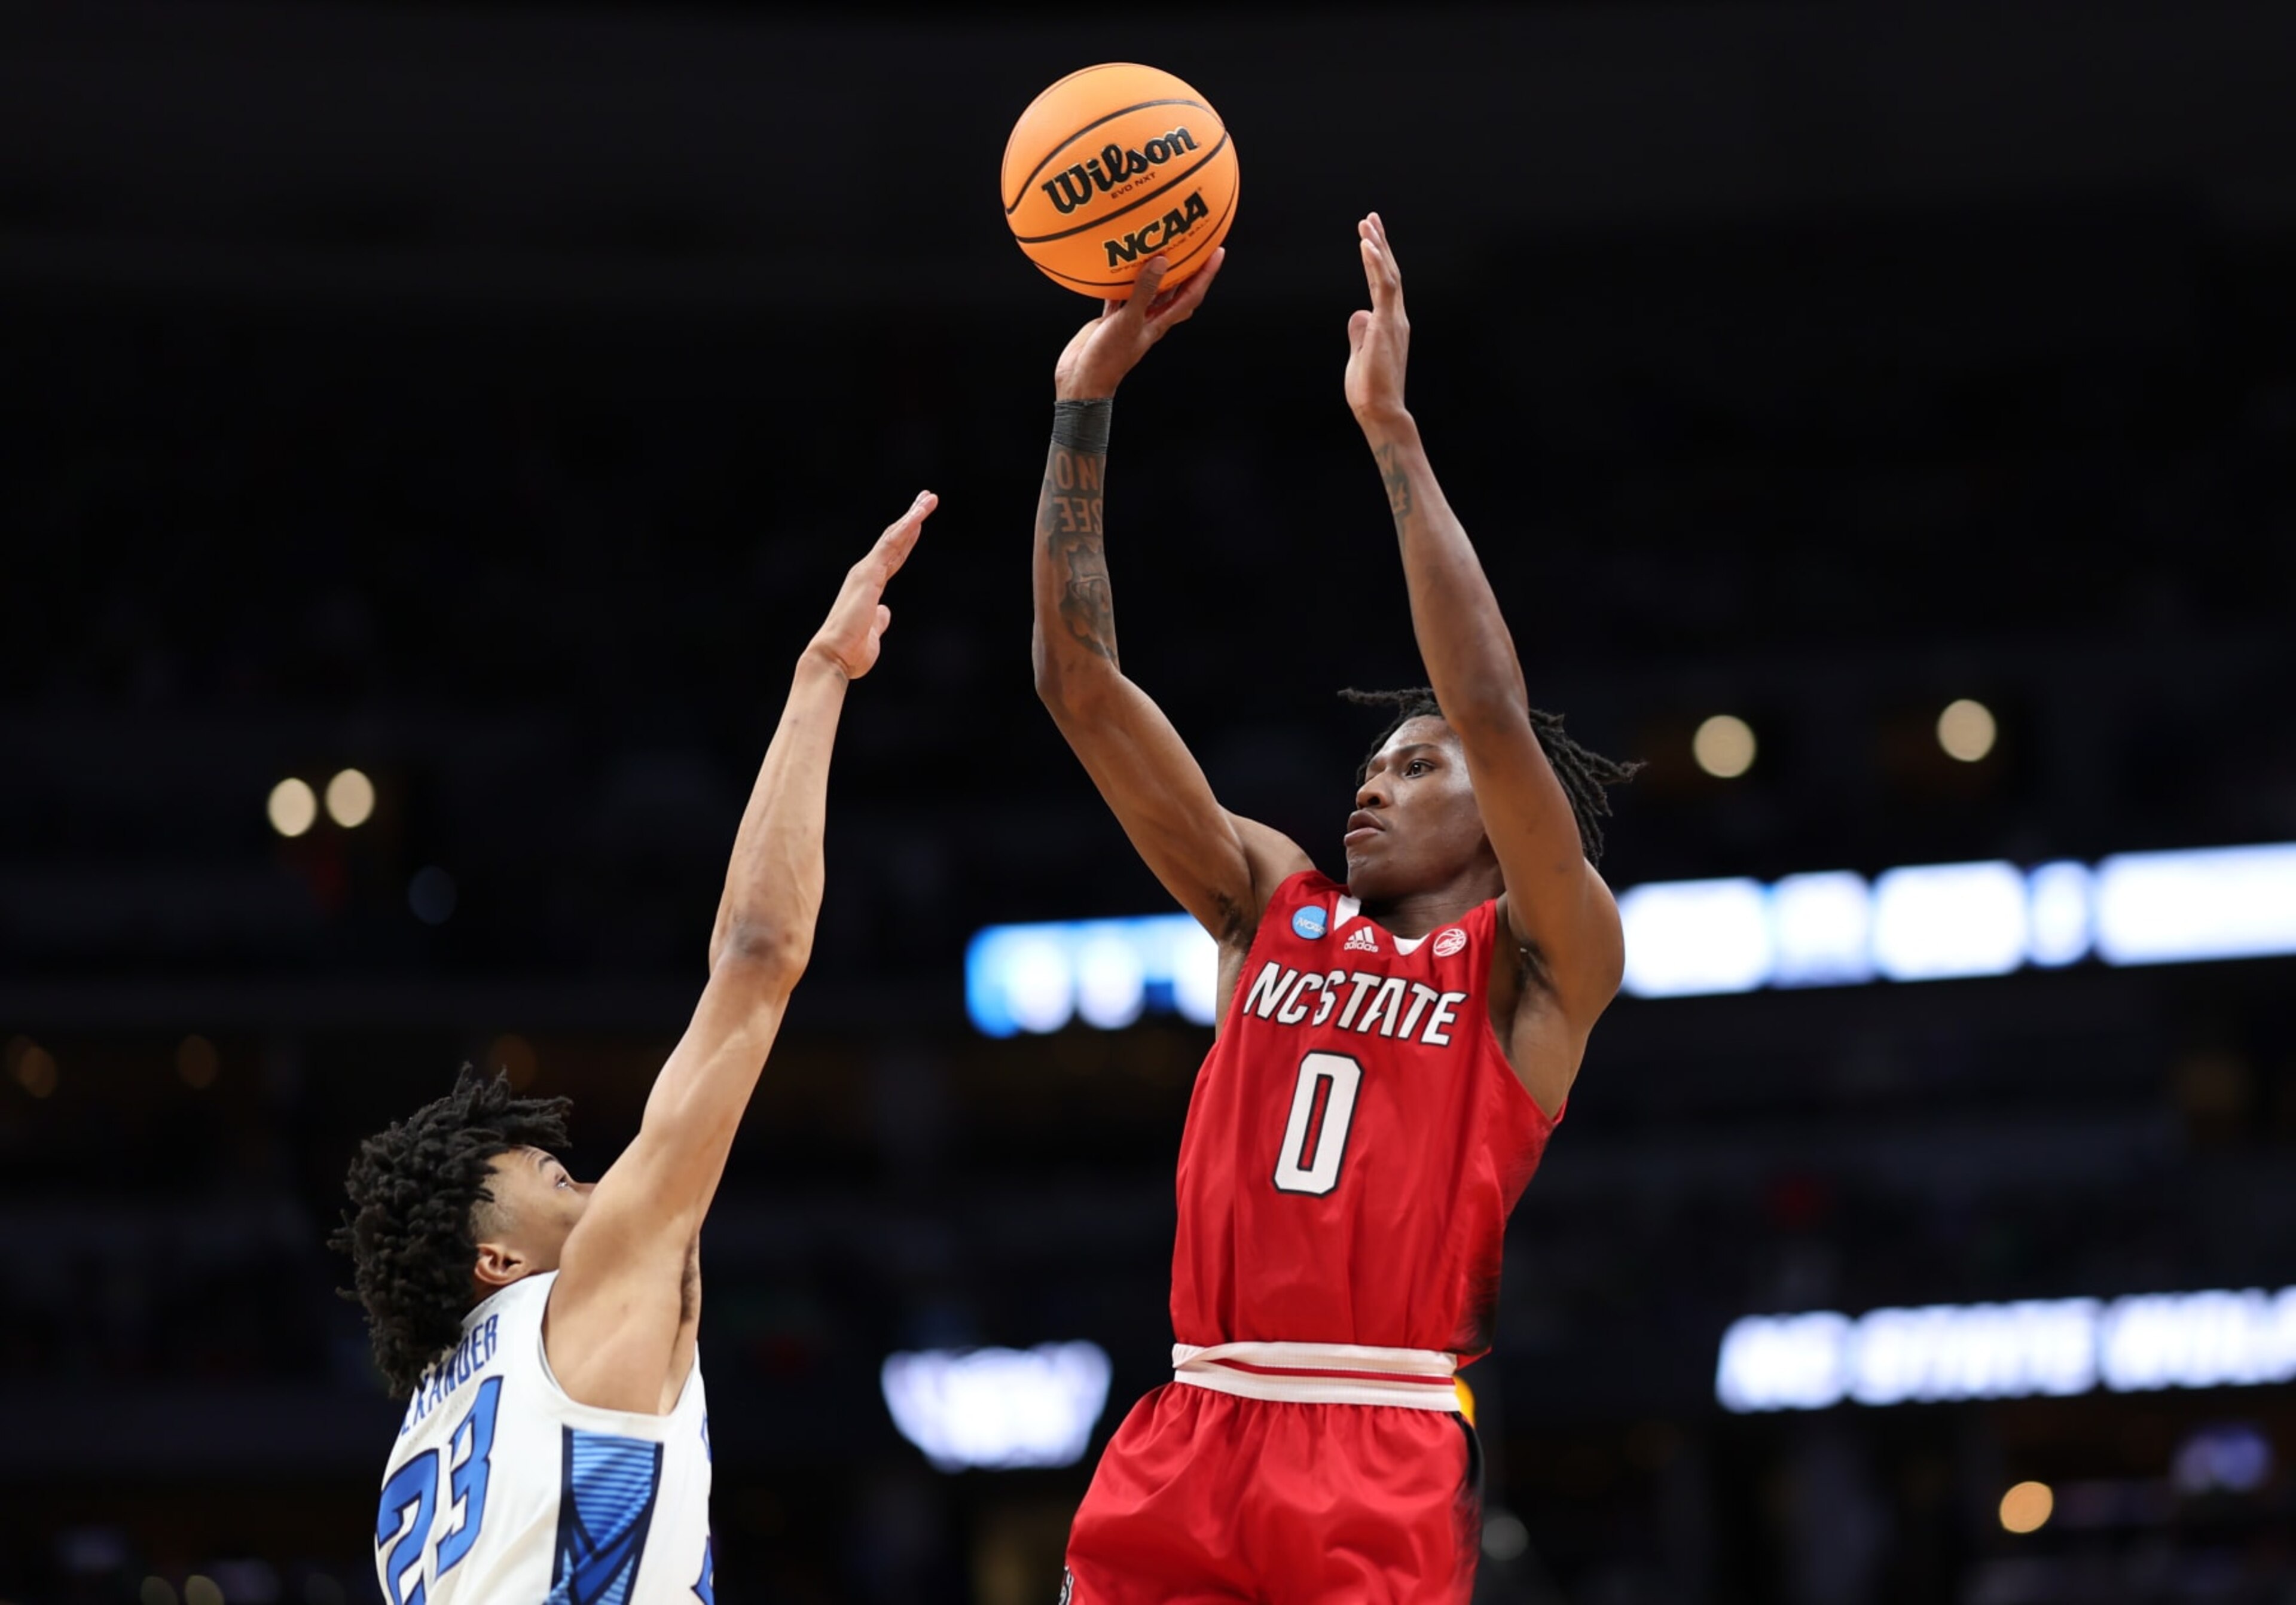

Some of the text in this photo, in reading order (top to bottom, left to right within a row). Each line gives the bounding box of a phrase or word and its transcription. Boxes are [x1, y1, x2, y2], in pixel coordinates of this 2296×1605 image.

[1042, 126, 1198, 216] Wilson
[1111, 172, 1156, 199] EVO NXT
[1103, 190, 1210, 267] NCAA
[1344, 939, 1379, 953] adidas
[1272, 1048, 1365, 1199] 0
[375, 1375, 504, 1605] 23
